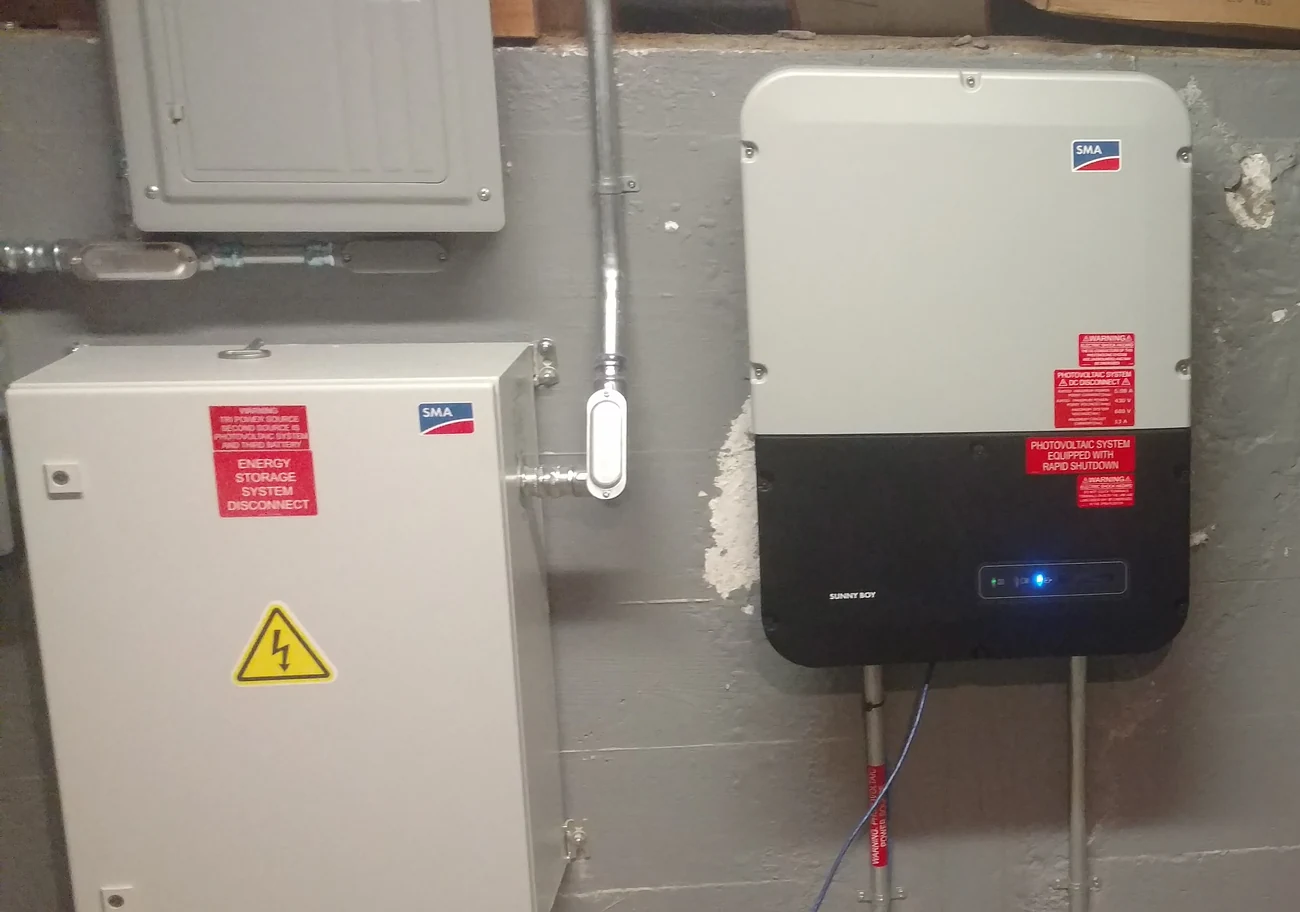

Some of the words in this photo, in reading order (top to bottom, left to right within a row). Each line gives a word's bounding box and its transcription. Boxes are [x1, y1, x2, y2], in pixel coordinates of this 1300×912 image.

[1076, 145, 1103, 155] SMA
[1088, 334, 1126, 342] WARNING
[1057, 371, 1105, 379] PHOTOVOLTAIC
[1106, 370, 1132, 378] SYSTEM
[1079, 378, 1121, 386] DISCONNECT
[422, 406, 454, 418] SMA
[1030, 440, 1095, 450] PHOTOVOLTAIC
[1096, 439, 1131, 449] SYSTEM
[1047, 451, 1091, 461] EQUIPPED
[1092, 450, 1114, 459] WITH
[237, 458, 292, 469] ENERGY
[1042, 462, 1068, 471] RAPID
[1070, 461, 1119, 471] SHUTDOWN
[235, 471, 297, 483] STORAGE
[241, 485, 294, 497] SYSTEM
[227, 499, 310, 511] DISCONNECT
[829, 592, 859, 600] SUNNY
[859, 591, 876, 599] BOY
